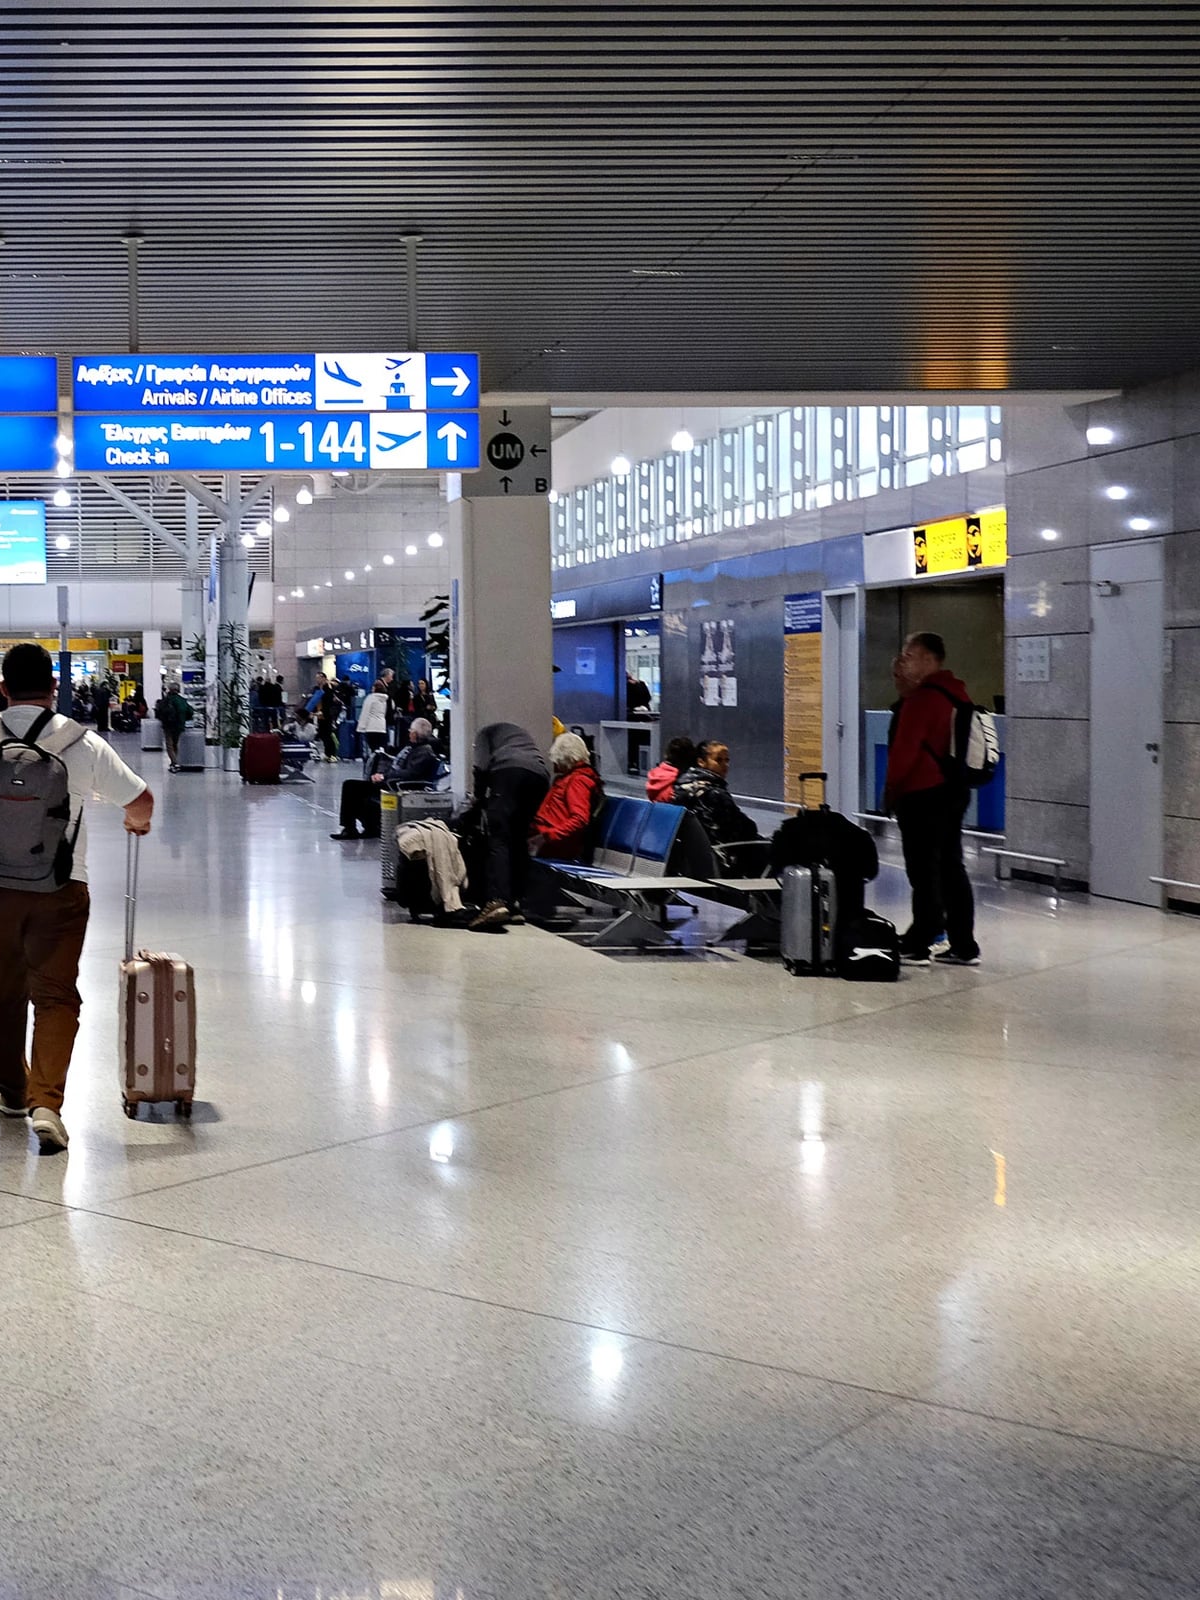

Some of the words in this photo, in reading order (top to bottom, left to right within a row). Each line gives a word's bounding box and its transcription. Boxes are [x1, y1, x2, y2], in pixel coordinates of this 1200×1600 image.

[135, 364, 144, 383] /
[141, 388, 197, 405] Arrivals
[199, 388, 208, 405] /
[209, 387, 258, 405] Airline
[261, 387, 313, 405] Offices
[259, 421, 367, 463] 1-144
[105, 447, 170, 465] Check-in
[491, 443, 521, 460] UM
[535, 477, 548, 493] B
